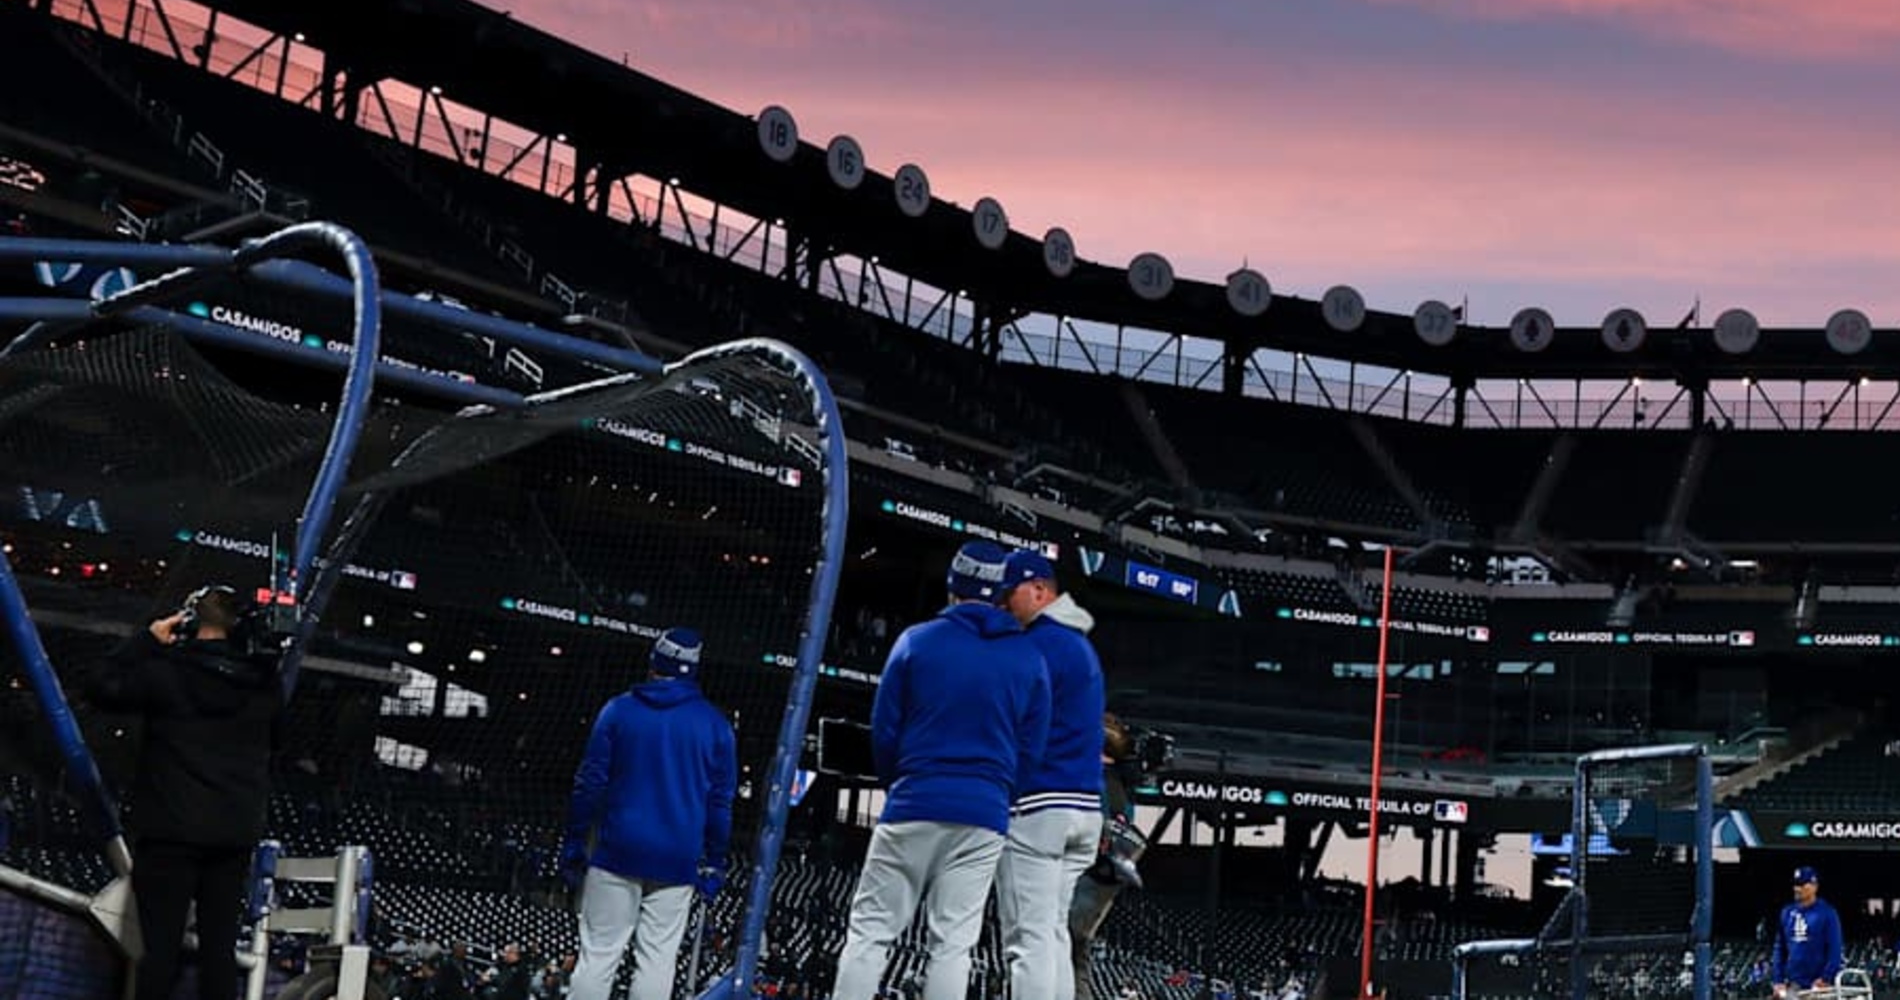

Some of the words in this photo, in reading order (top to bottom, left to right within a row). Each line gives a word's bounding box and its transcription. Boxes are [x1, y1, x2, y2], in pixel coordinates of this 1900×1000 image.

[768, 119, 788, 147] 18
[836, 147, 855, 177] 16
[901, 175, 923, 203] 24
[979, 208, 999, 234] 17
[1139, 264, 1163, 288] 31
[1238, 280, 1262, 306] 41
[210, 306, 301, 343] CASAMIGOS
[895, 502, 952, 529] CASAMIGOS
[1293, 608, 1358, 626] CASAMIGOS
[1547, 631, 1613, 644] CASAMIGOS
[1632, 633, 1673, 643] OFFICIAL
[1813, 633, 1881, 646] CASAMIGOS
[1291, 792, 1351, 809] OFFICIAL
[1355, 797, 1411, 815] TEUILA
[1412, 802, 1432, 815] OF
